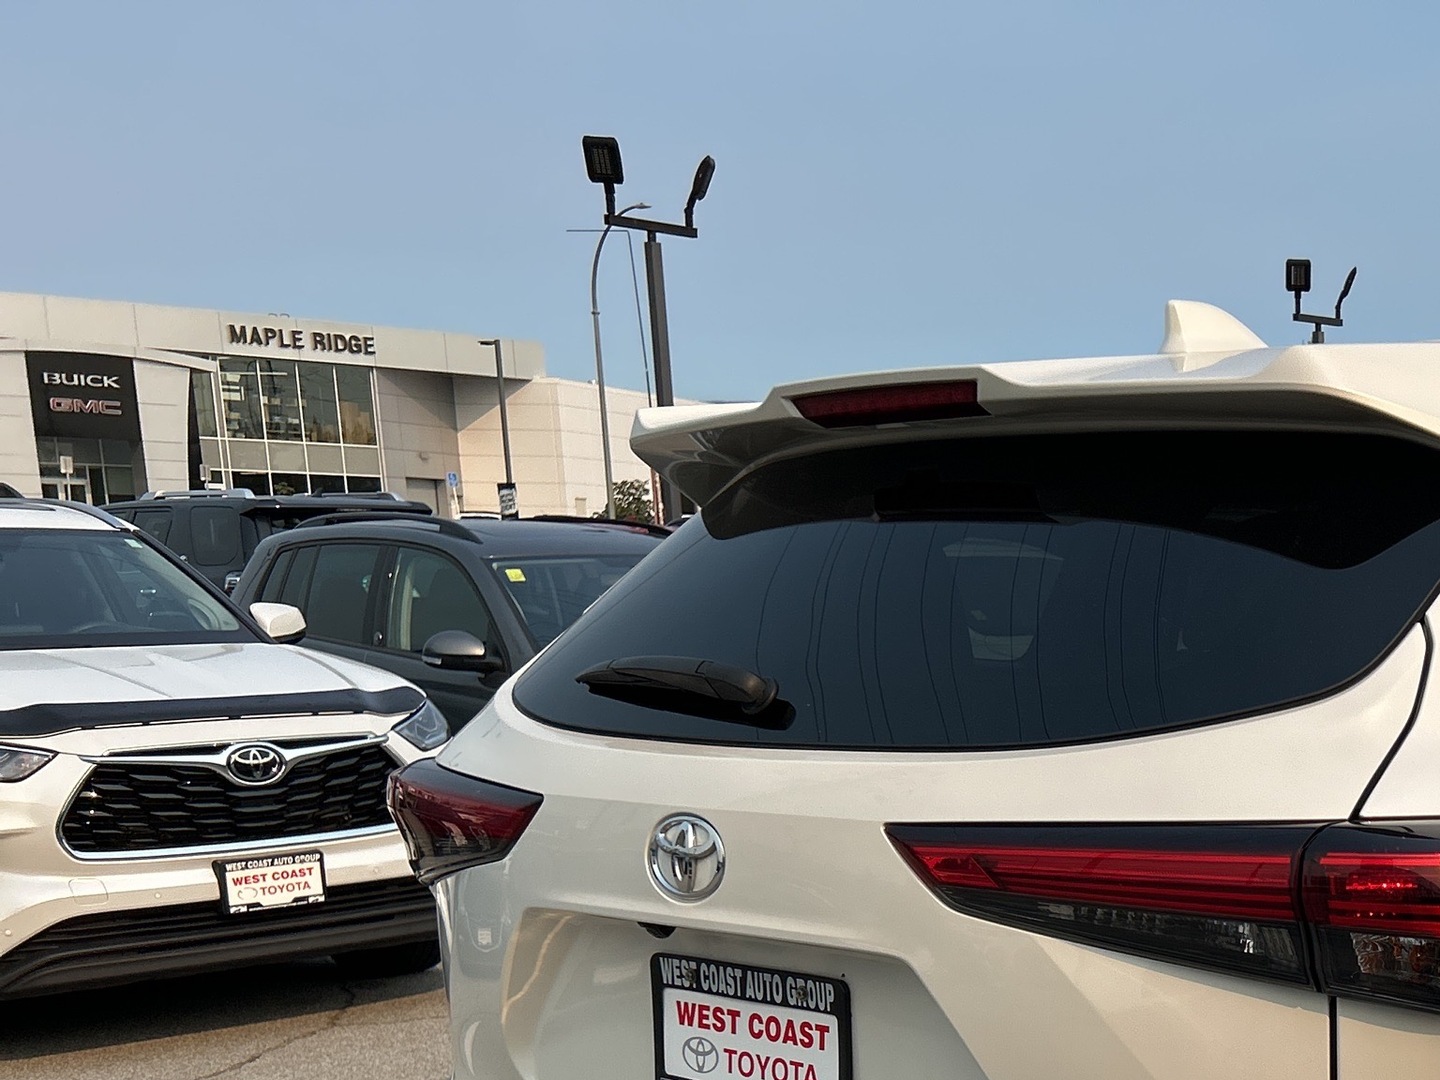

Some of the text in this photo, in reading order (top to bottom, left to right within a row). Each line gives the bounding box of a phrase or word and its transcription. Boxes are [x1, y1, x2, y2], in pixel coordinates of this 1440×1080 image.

[228, 324, 376, 356] MAPLE RIDGE
[43, 371, 120, 389] BUICK
[50, 396, 122, 416] GMC
[225, 861, 246, 872] WEST
[248, 859, 273, 869] COAST
[273, 856, 293, 866] AUTO
[232, 867, 314, 886] WEST COAST
[260, 881, 311, 896] TOYOTA
[659, 956, 698, 989] WEST
[700, 963, 743, 997] COAST
[745, 970, 783, 1004] AUTO
[676, 1000, 830, 1051] WEST COAST
